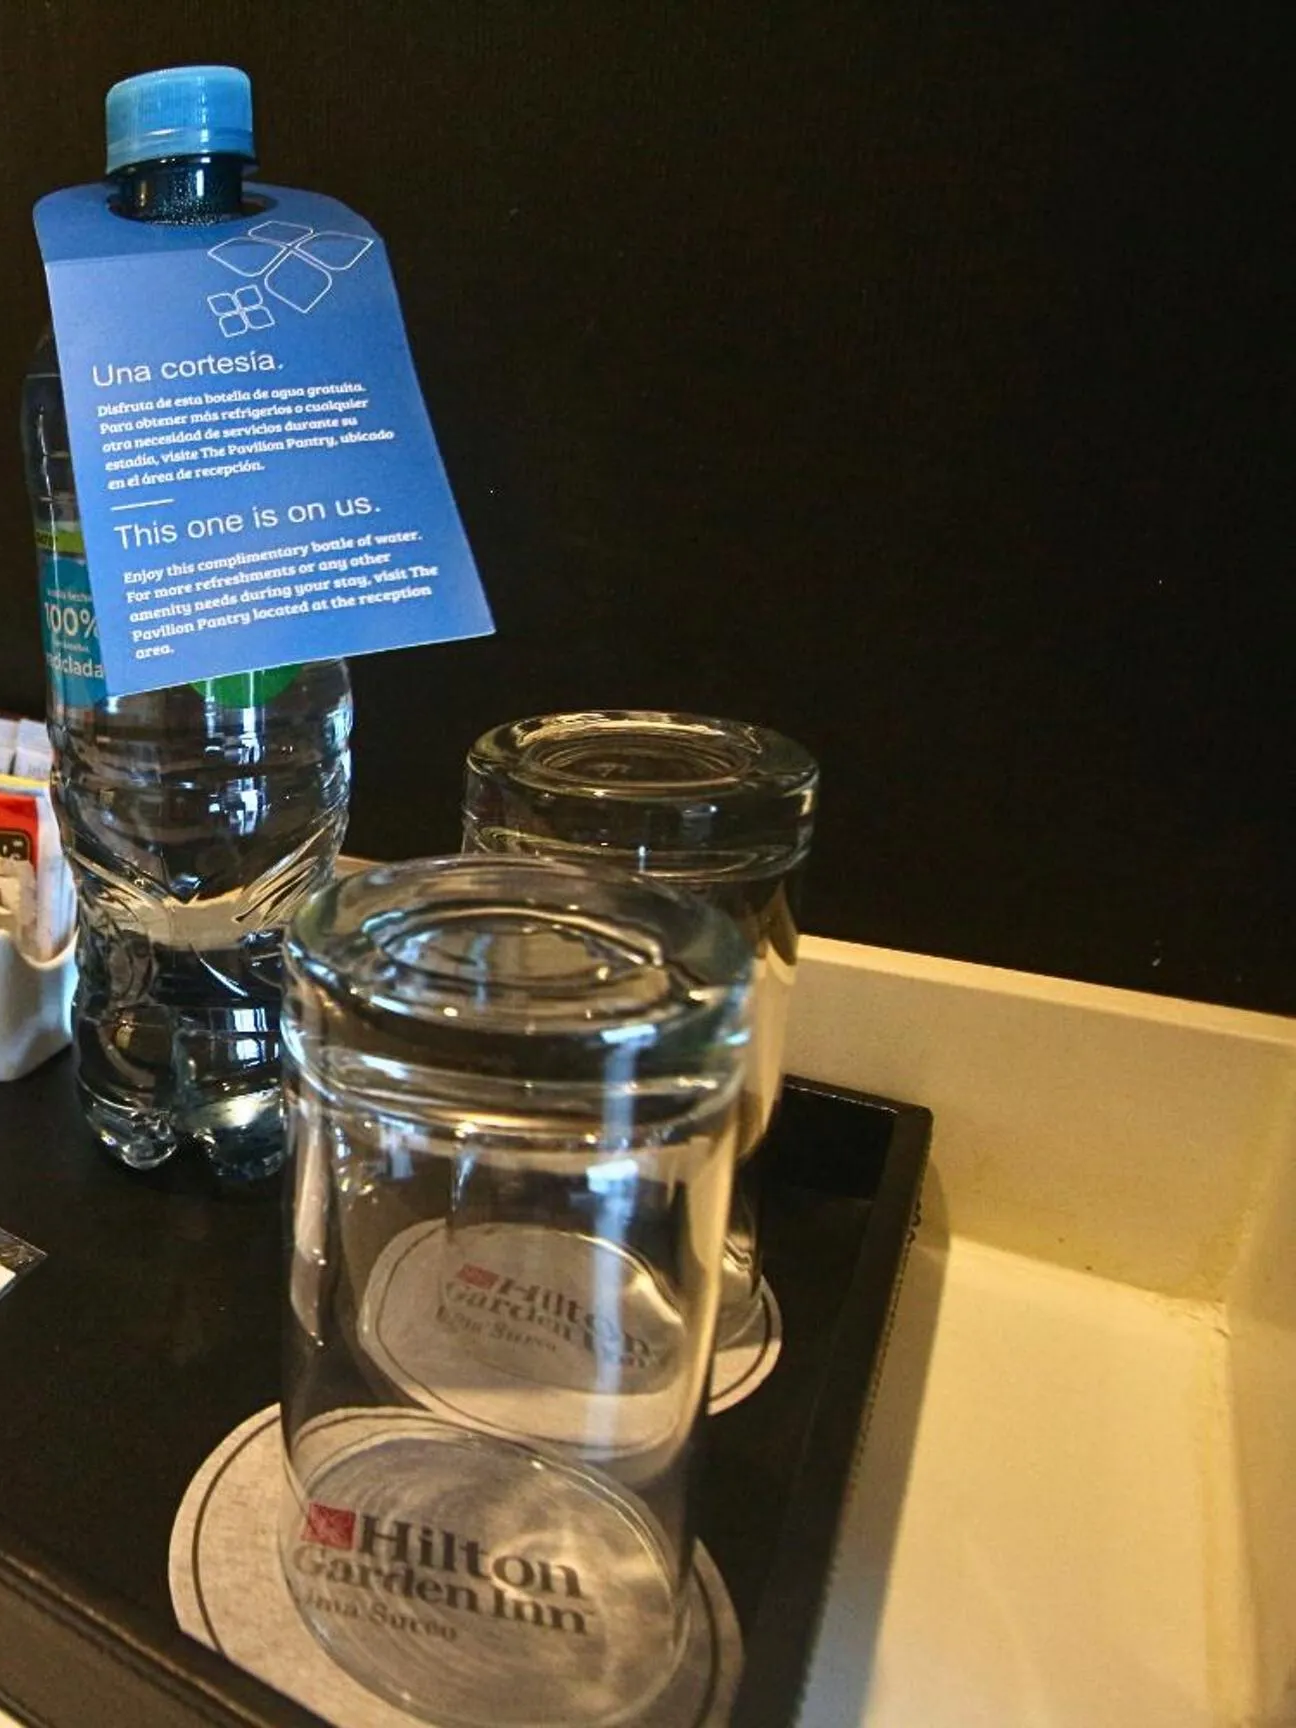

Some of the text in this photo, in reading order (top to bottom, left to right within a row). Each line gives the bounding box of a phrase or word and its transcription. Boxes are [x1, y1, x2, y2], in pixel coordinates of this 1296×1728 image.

[92, 350, 284, 387] Una cortesía.
[96, 382, 367, 417] Disfruta de esta botella de agua gratuita.
[100, 398, 370, 435] Para obtener más refrigerios o cualquier
[102, 416, 359, 453] otra necesidad de servicios durante su
[161, 450, 199, 464] visite
[199, 446, 226, 459] The
[227, 440, 285, 456] Pavilion
[285, 435, 339, 449] Pantry,
[339, 429, 396, 444] ubicado
[107, 459, 265, 490] en el área de recepción.
[113, 496, 382, 550] This one is on us.
[123, 531, 423, 585] Enjoy this complimentary bottle of water.
[126, 552, 392, 604] For more refreshments or any other
[129, 603, 193, 623] amenity
[194, 595, 237, 612] needs
[240, 585, 294, 603] during
[294, 580, 331, 596] your
[373, 568, 408, 584] visit
[408, 565, 439, 578] The
[132, 585, 433, 643] Pavilion Pantry located at the reception
[135, 643, 175, 660] area.
[359, 1513, 589, 1599] Hilton
[292, 1545, 588, 1635] Garden Inn
